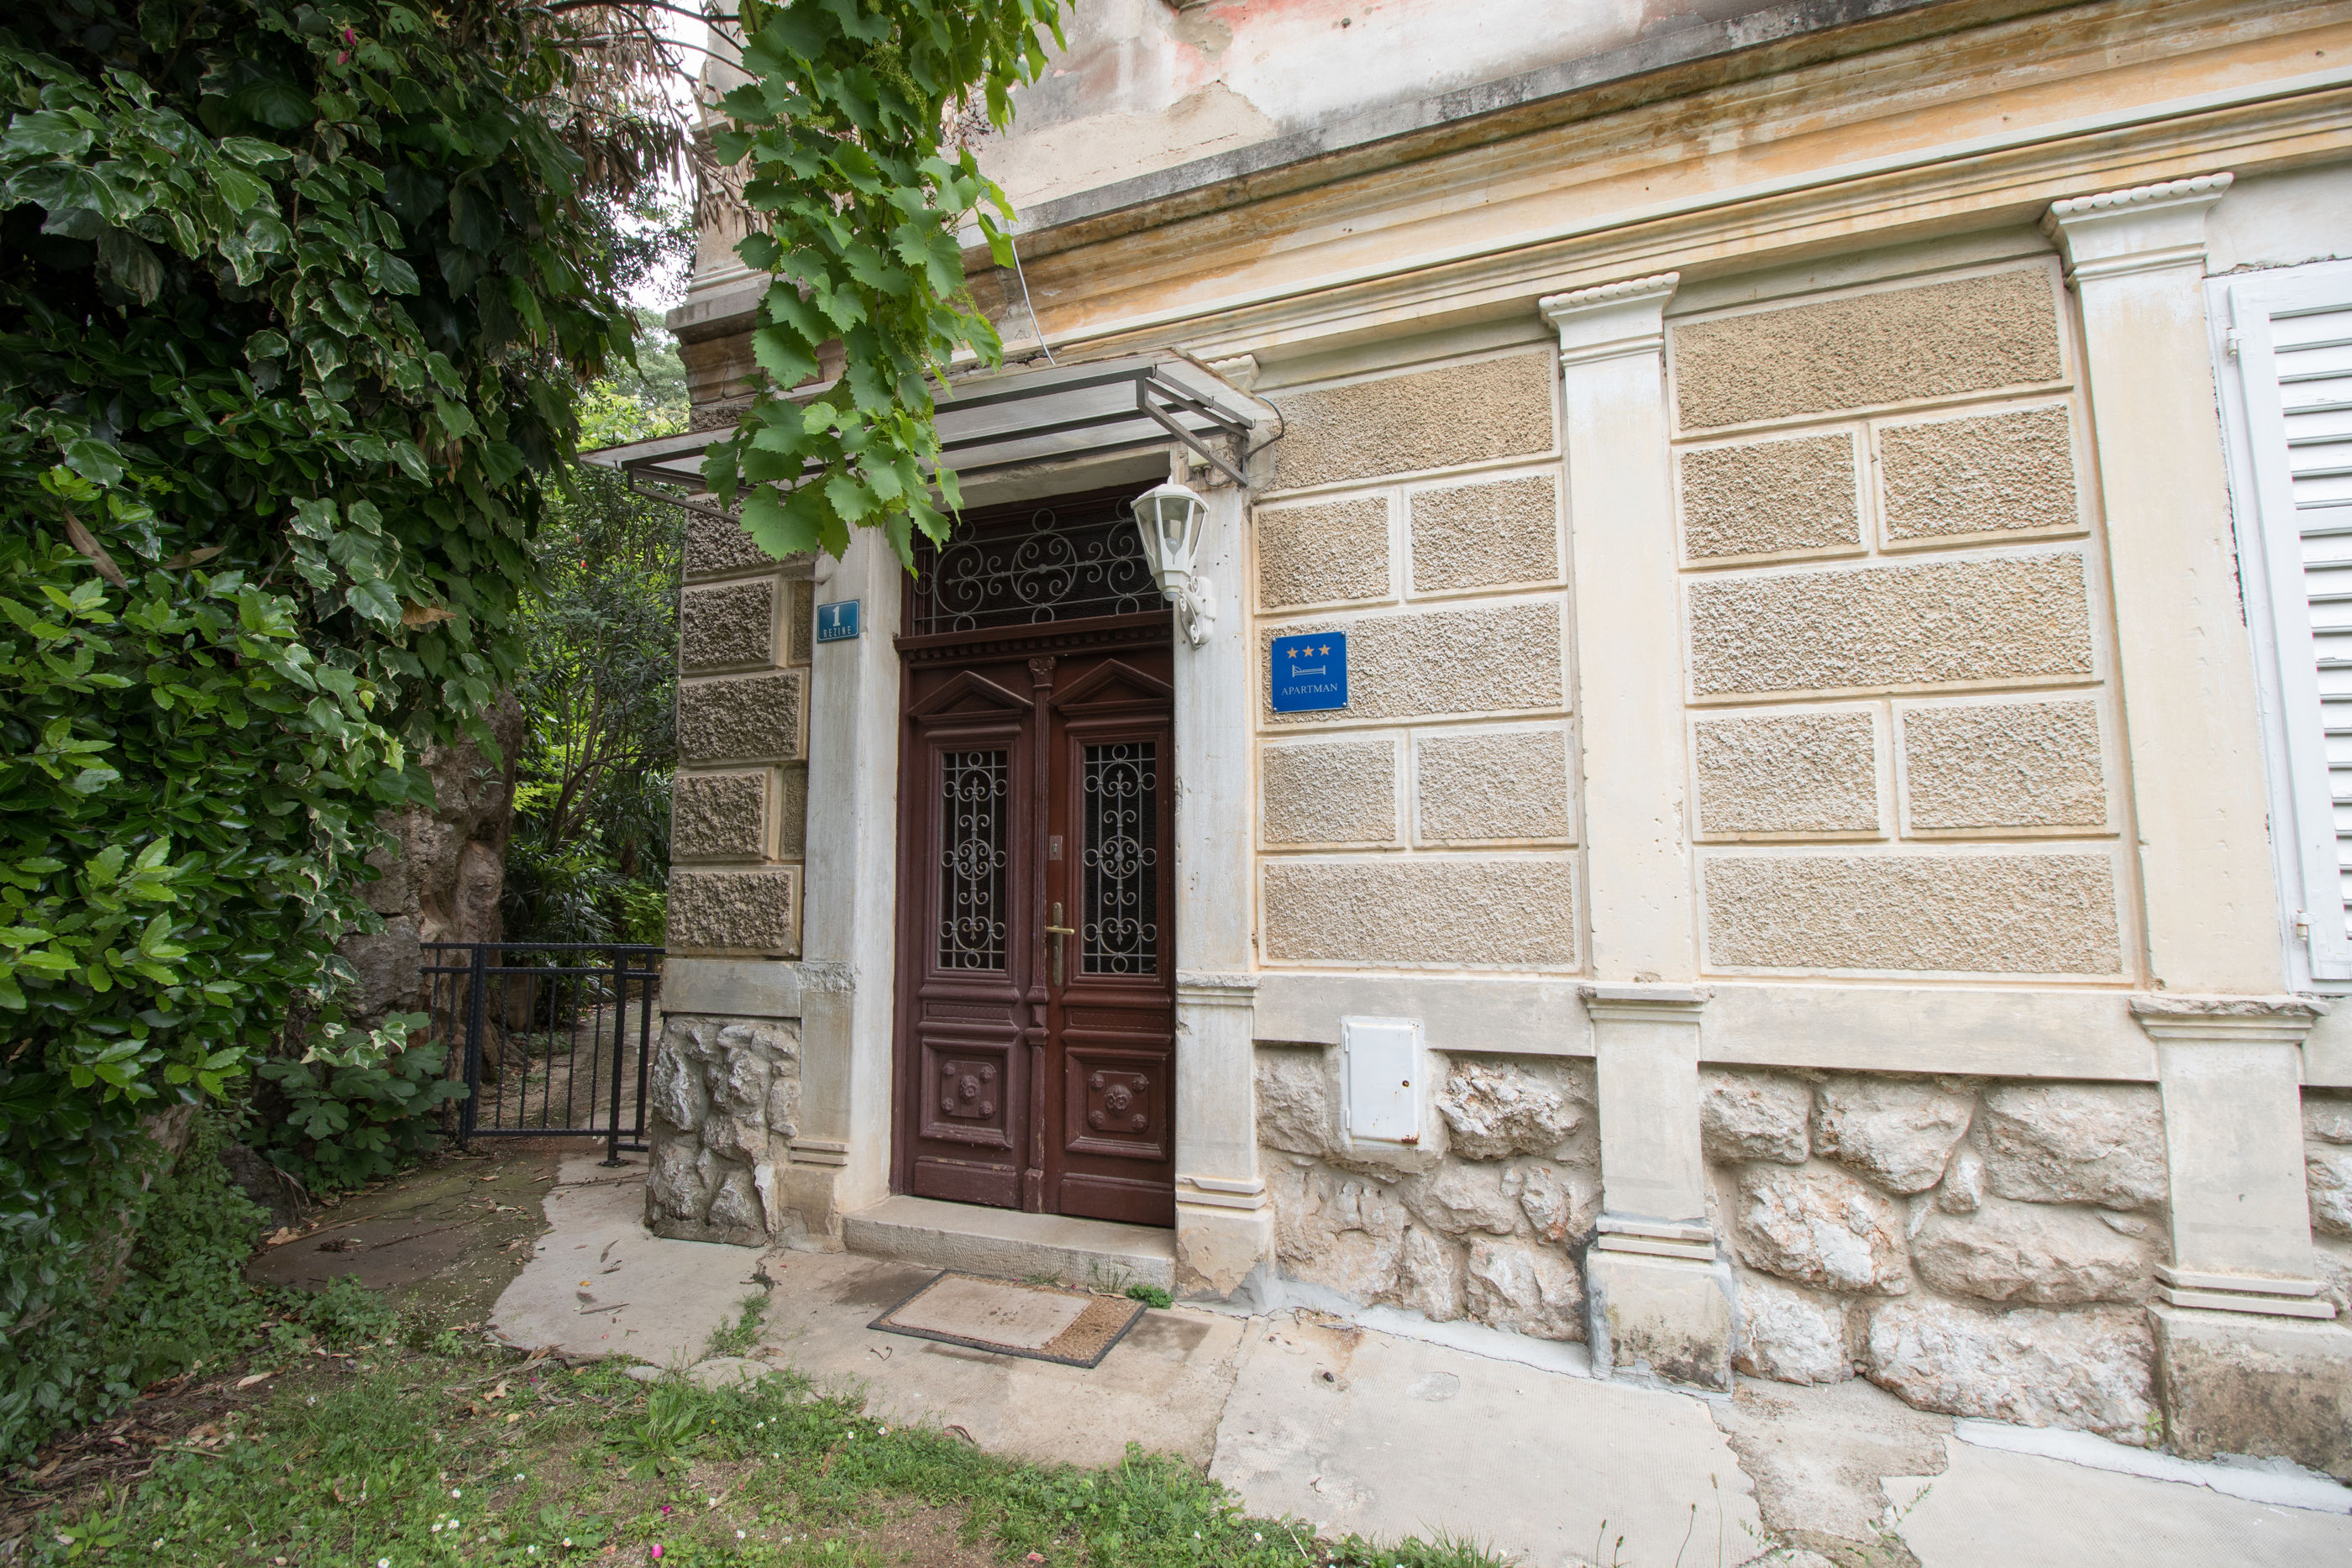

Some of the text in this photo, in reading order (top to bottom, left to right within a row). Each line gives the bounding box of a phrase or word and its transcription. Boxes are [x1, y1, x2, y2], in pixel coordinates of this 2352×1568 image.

[832, 606, 840, 627] 1
[823, 626, 852, 637] REZINE
[1281, 683, 1338, 695] APARTMAN
